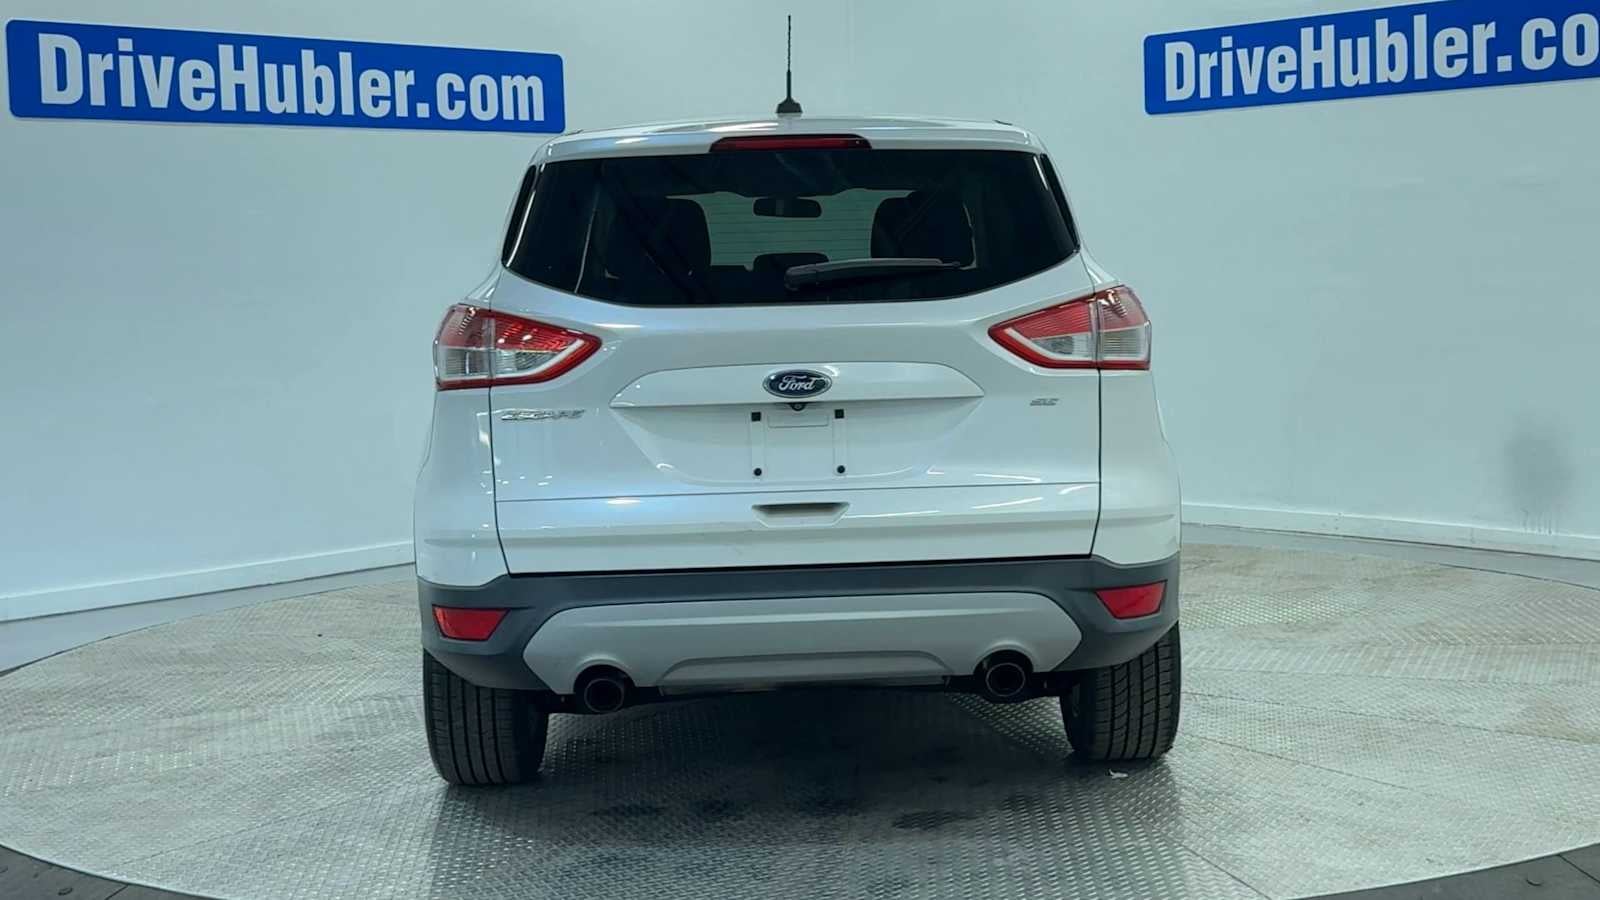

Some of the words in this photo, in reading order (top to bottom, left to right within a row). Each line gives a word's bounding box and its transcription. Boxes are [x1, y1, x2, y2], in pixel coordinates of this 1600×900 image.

[38, 32, 545, 122] DriveHubler.com
[1164, 13, 1600, 102] DriveHubler.co
[778, 375, 824, 391] Ford
